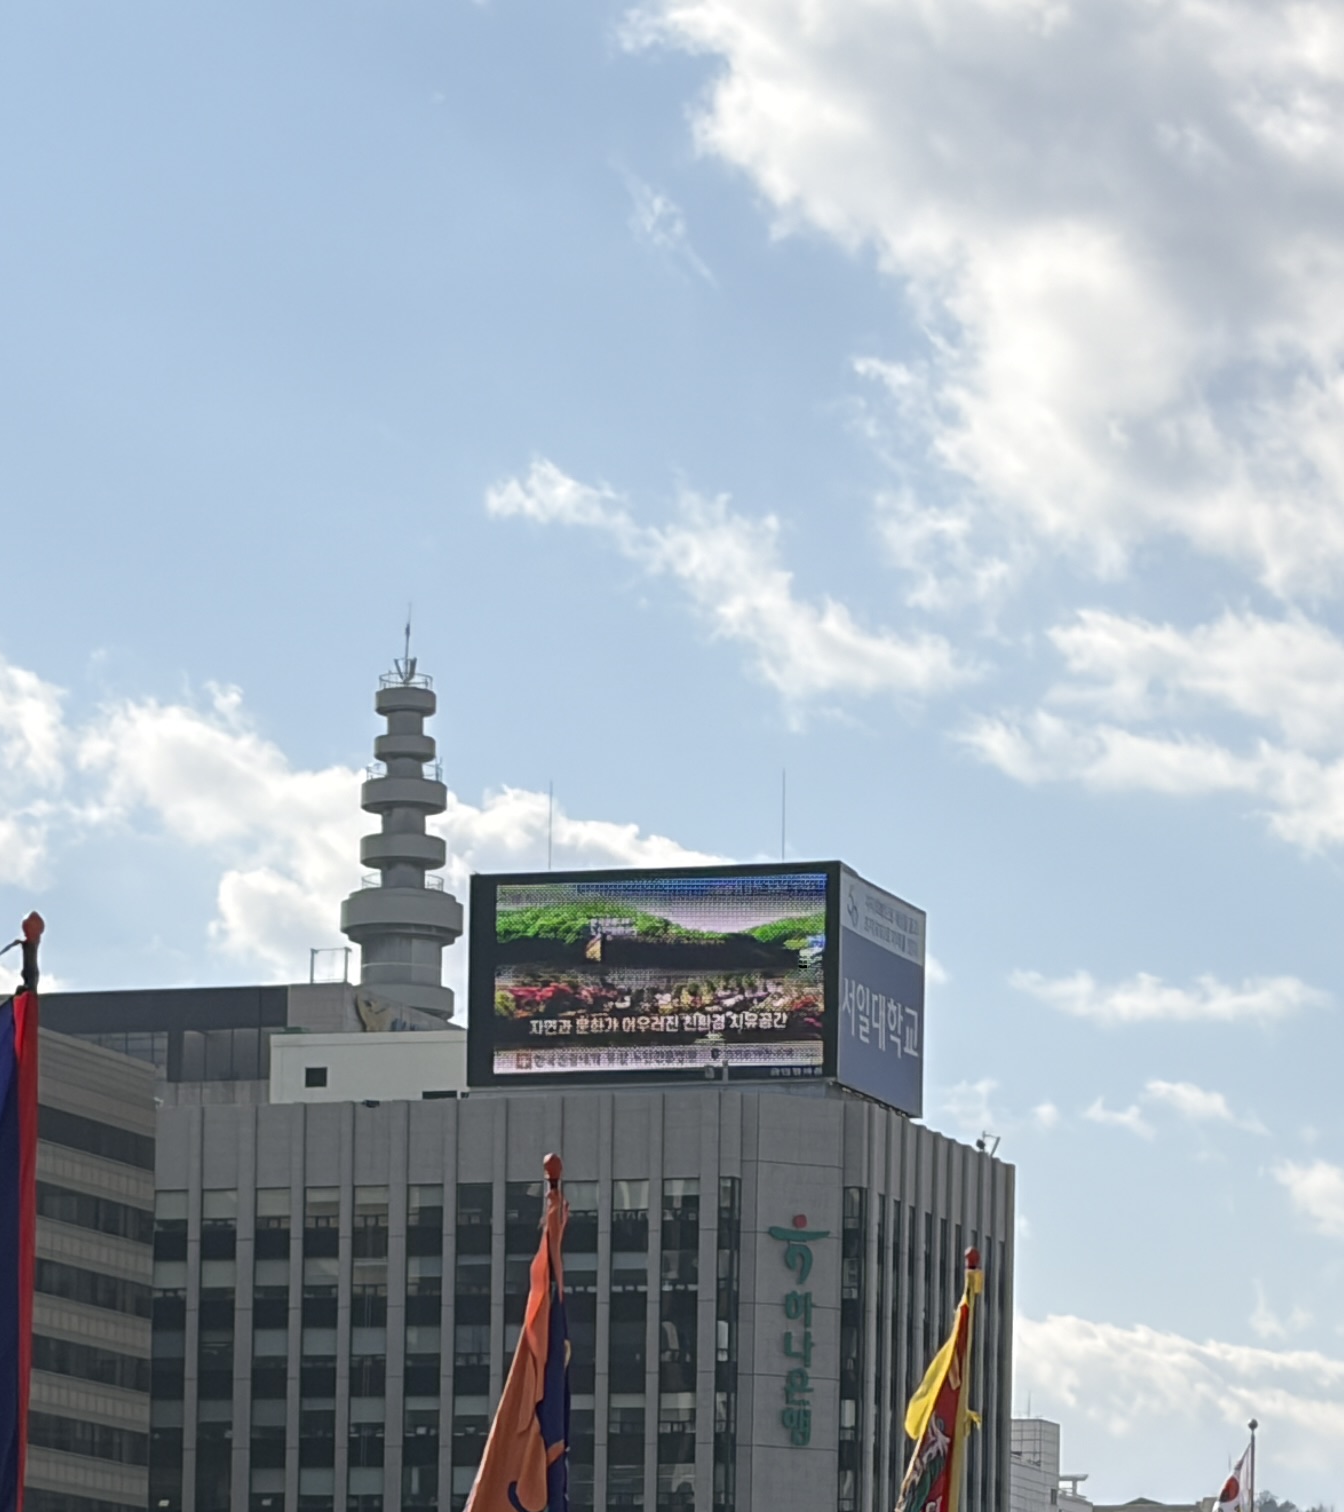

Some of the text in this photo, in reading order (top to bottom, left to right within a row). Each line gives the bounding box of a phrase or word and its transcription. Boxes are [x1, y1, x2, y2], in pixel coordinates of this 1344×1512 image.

[529, 1019, 573, 1036] 자연과
[575, 1016, 619, 1035] 문화가
[622, 1014, 679, 1033] 어우러진
[729, 1011, 788, 1030] 치유공간
[842, 977, 919, 1058] 서일대학교
[780, 1291, 815, 1447] 하나은행
